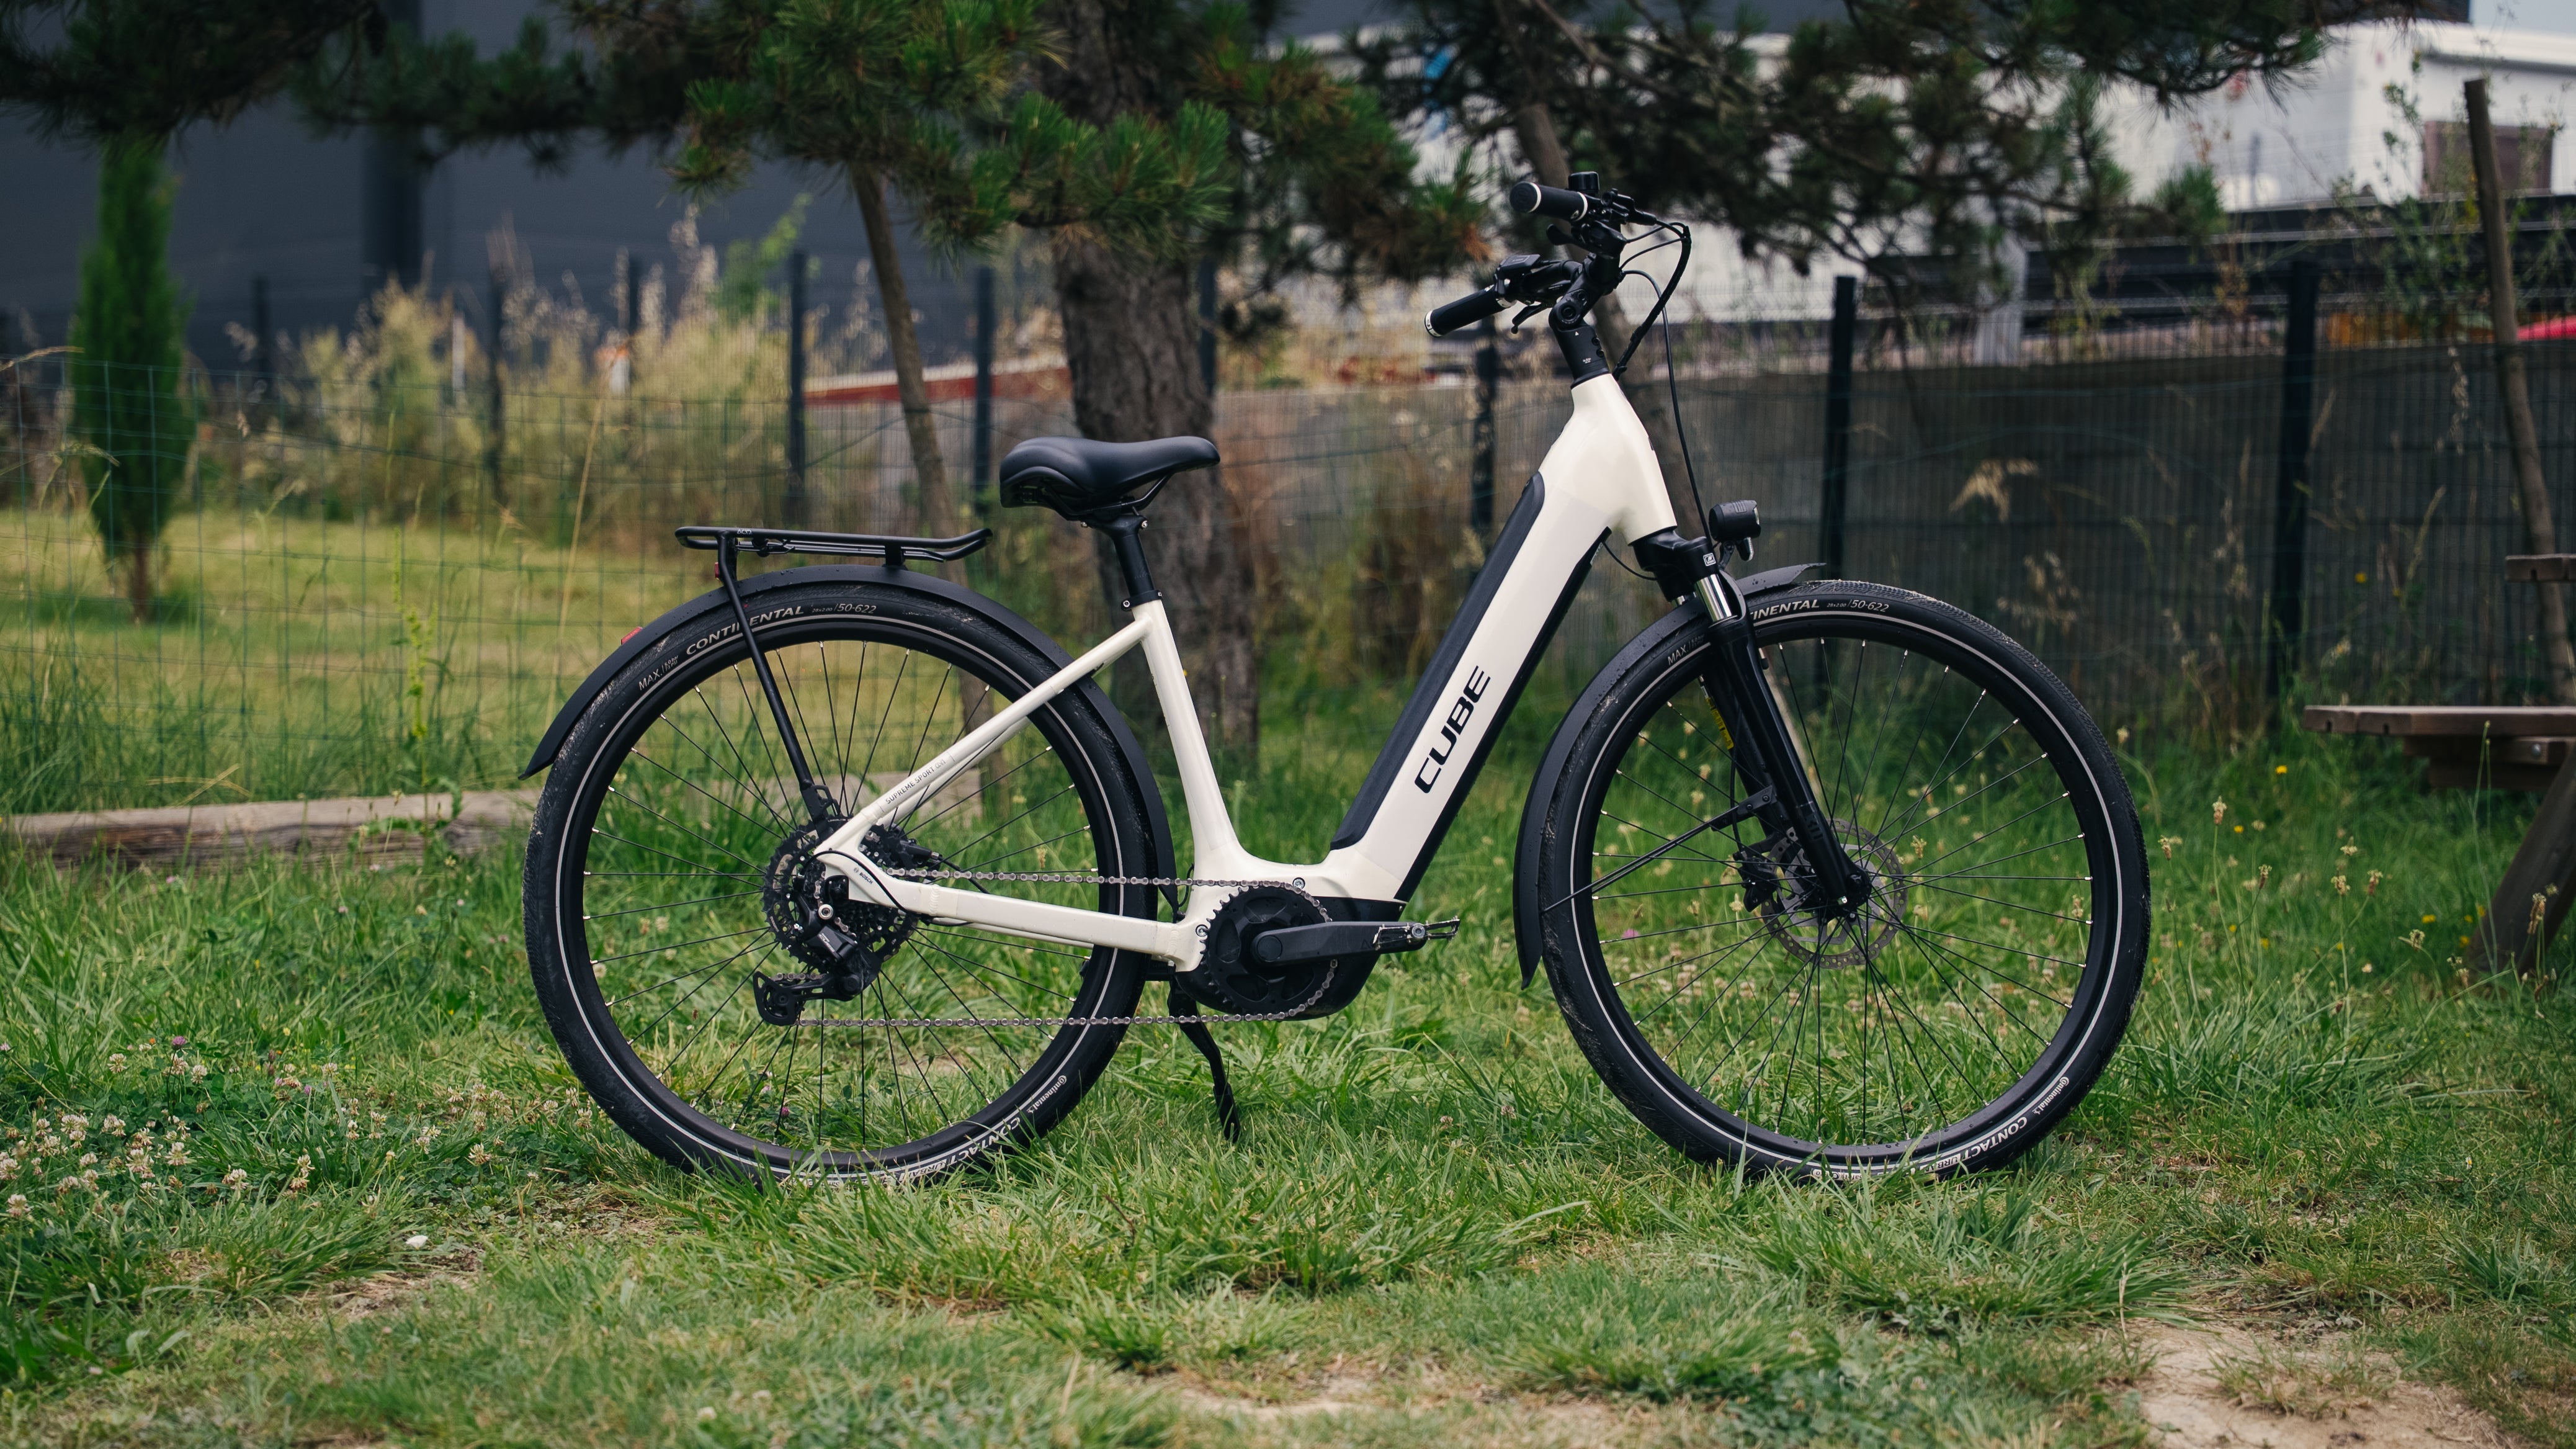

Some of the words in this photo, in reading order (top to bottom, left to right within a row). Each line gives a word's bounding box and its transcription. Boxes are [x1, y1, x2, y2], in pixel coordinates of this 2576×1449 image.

[686, 606, 804, 655] CONTIENTAL
[1415, 665, 1491, 793] CUBE
[885, 781, 916, 804] SUPREME
[915, 767, 934, 783] SPORT
[1964, 1117, 2028, 1162] CONTACT
